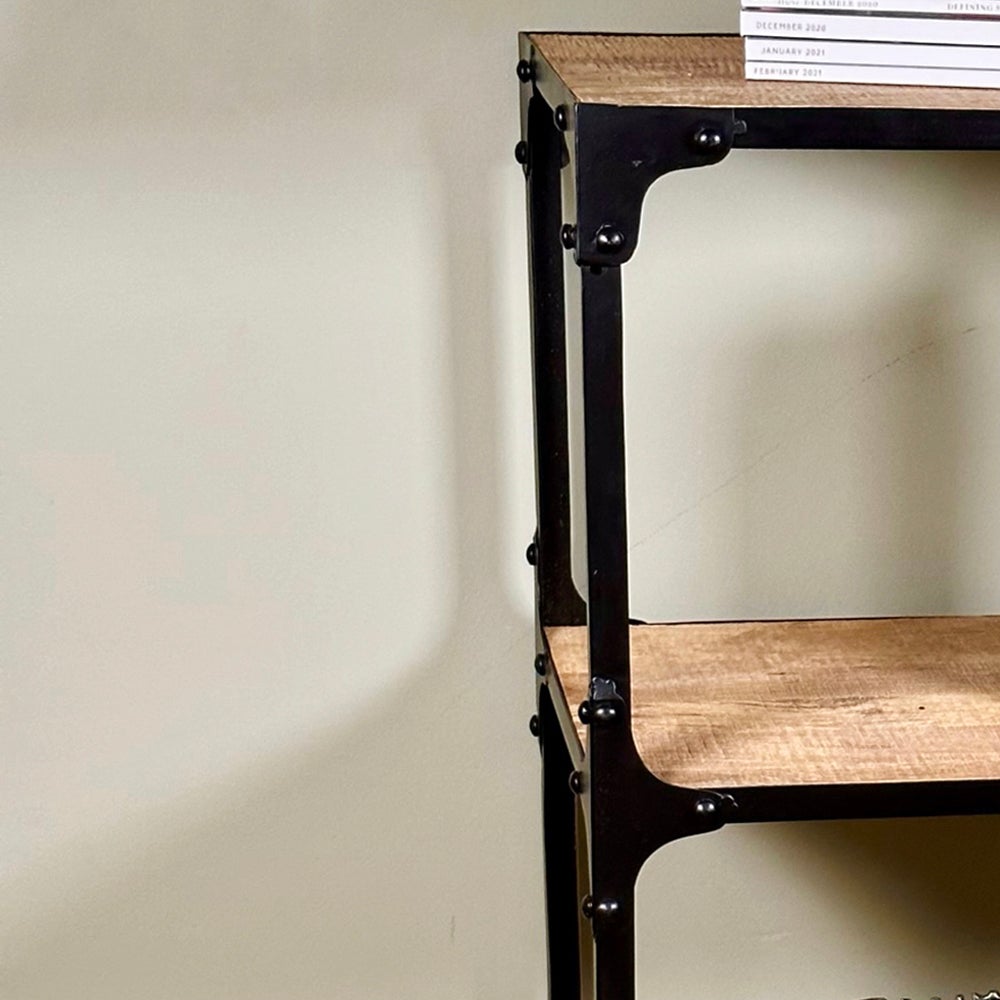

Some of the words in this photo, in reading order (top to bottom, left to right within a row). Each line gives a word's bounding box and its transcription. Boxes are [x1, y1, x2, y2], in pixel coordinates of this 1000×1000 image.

[947, 3, 993, 11] DEFINING
[756, 21, 803, 31] DECEMBER
[805, 23, 827, 32] 2020
[761, 46, 803, 56] JANUARY
[805, 48, 826, 57] 2021
[754, 67, 800, 76] FEBRUARY
[802, 68, 823, 77] 2021
